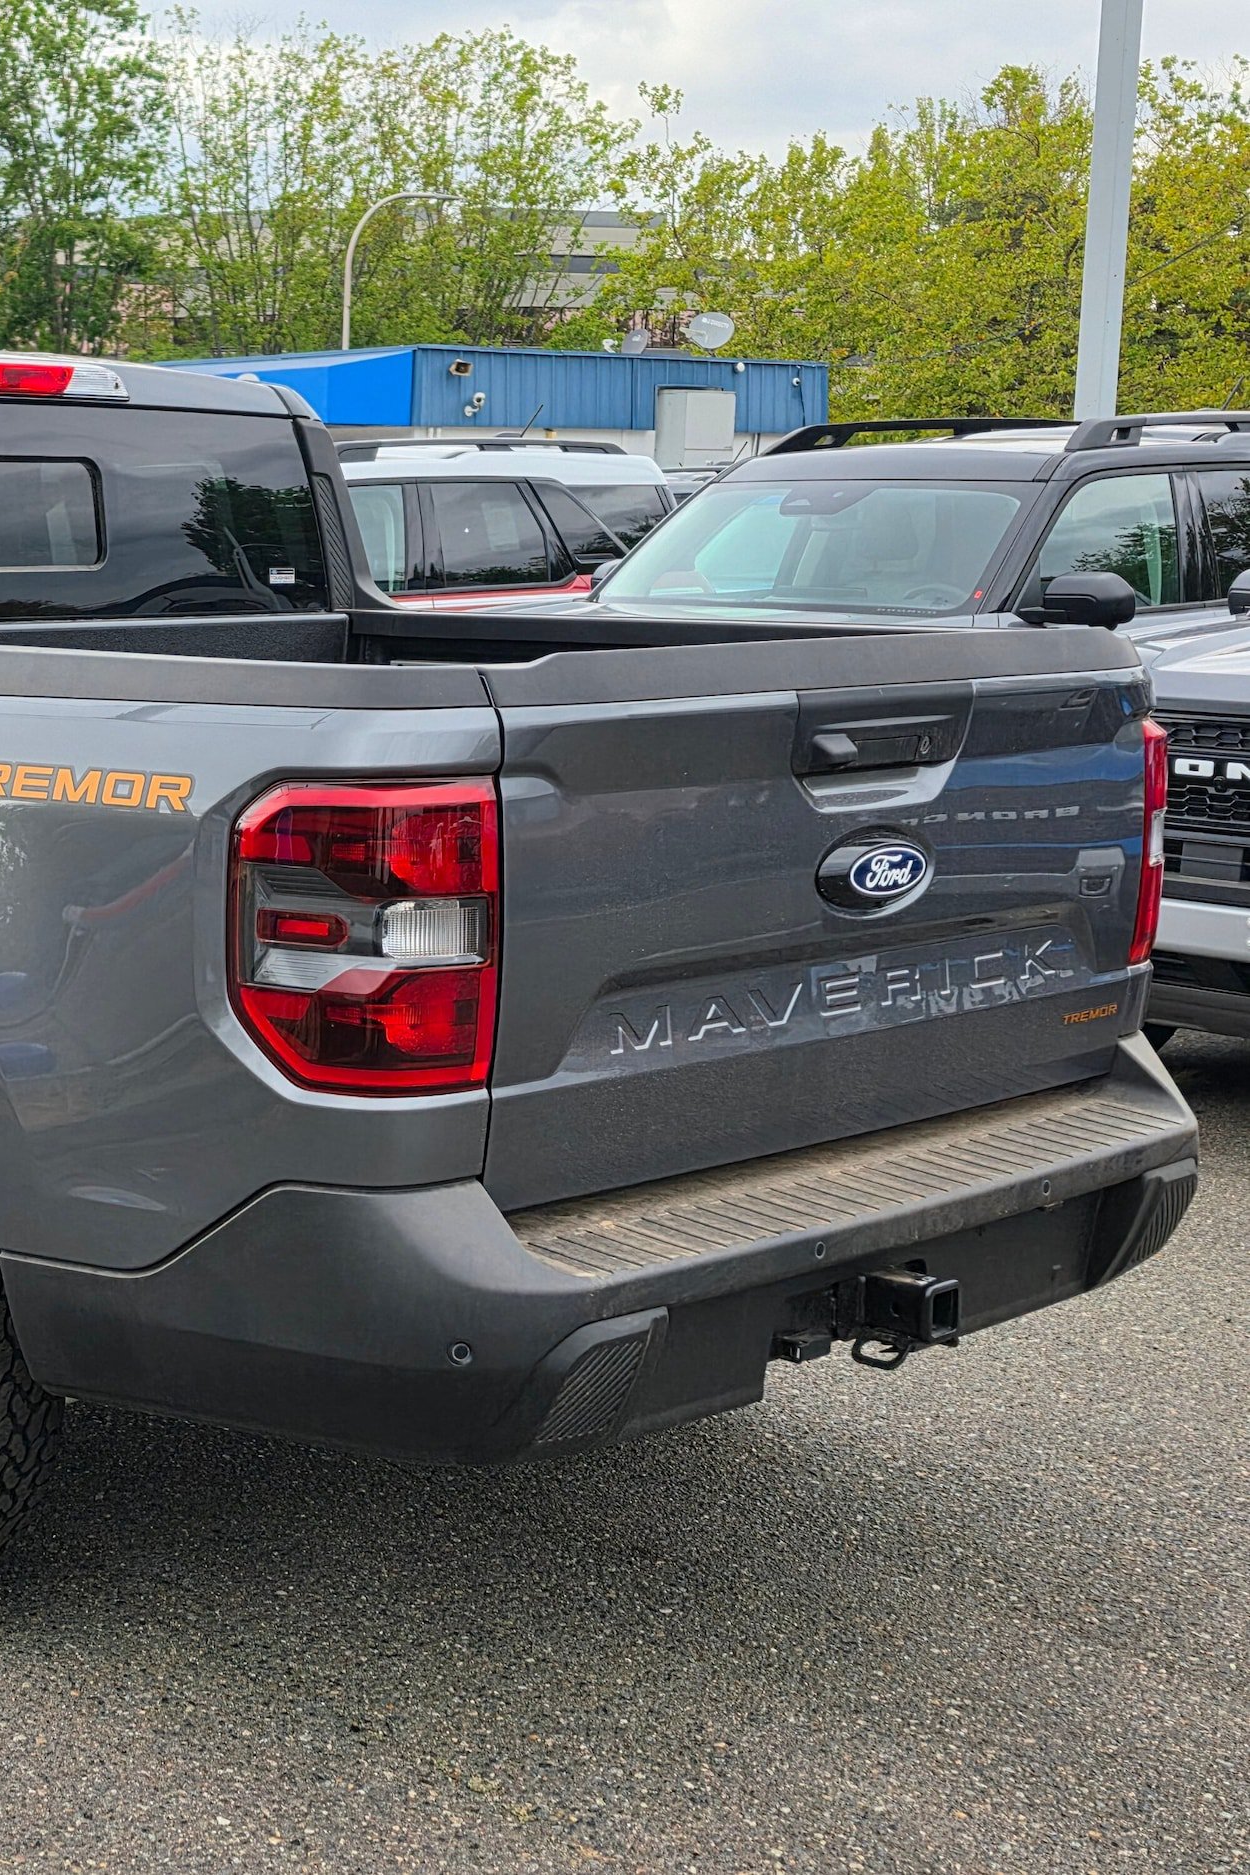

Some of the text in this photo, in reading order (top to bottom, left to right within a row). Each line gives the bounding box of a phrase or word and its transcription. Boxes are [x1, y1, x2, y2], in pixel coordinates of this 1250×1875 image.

[1175, 758, 1250, 780] ON
[866, 854, 914, 888] Ford
[609, 940, 1057, 1055] MAVERICK
[1062, 1003, 1118, 1025] TREMOR
